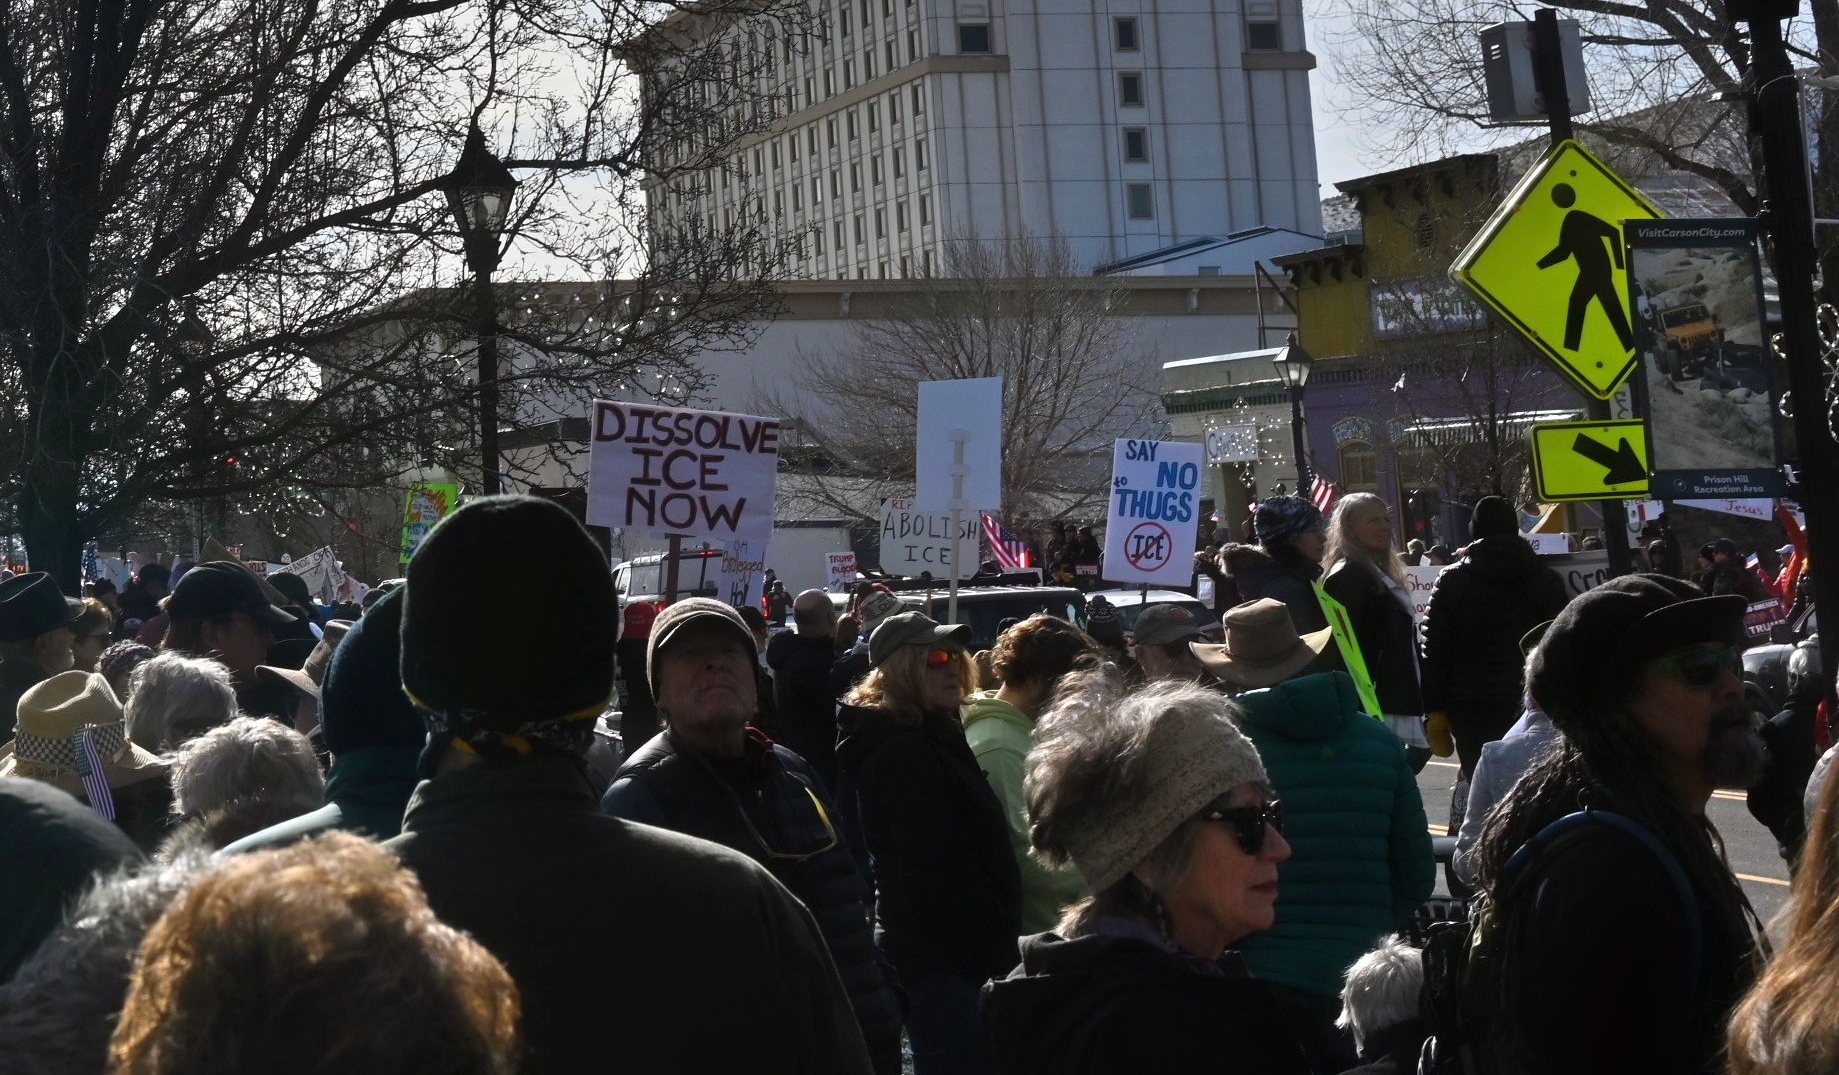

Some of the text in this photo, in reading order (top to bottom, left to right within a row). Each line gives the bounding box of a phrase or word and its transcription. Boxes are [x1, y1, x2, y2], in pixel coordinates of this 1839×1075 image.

[1637, 227, 1746, 239] VisitCarsonCity.com
[595, 402, 779, 454] DISSOLVE
[1125, 439, 1159, 462] SAY
[630, 447, 728, 491] ICE
[1156, 461, 1198, 490] NO
[1703, 474, 1749, 484] Prison Hill
[1113, 476, 1128, 488] to
[1694, 484, 1764, 494] Recreation Area
[625, 486, 747, 532] NOW
[1115, 488, 1192, 522] THUGS
[1725, 500, 1764, 517] Jesus
[882, 511, 977, 540] ABOLISH
[904, 545, 951, 565] ICE
[1130, 534, 1164, 561] ICE
[828, 554, 854, 564] TRUMP
[831, 564, 856, 574] BLOOD
